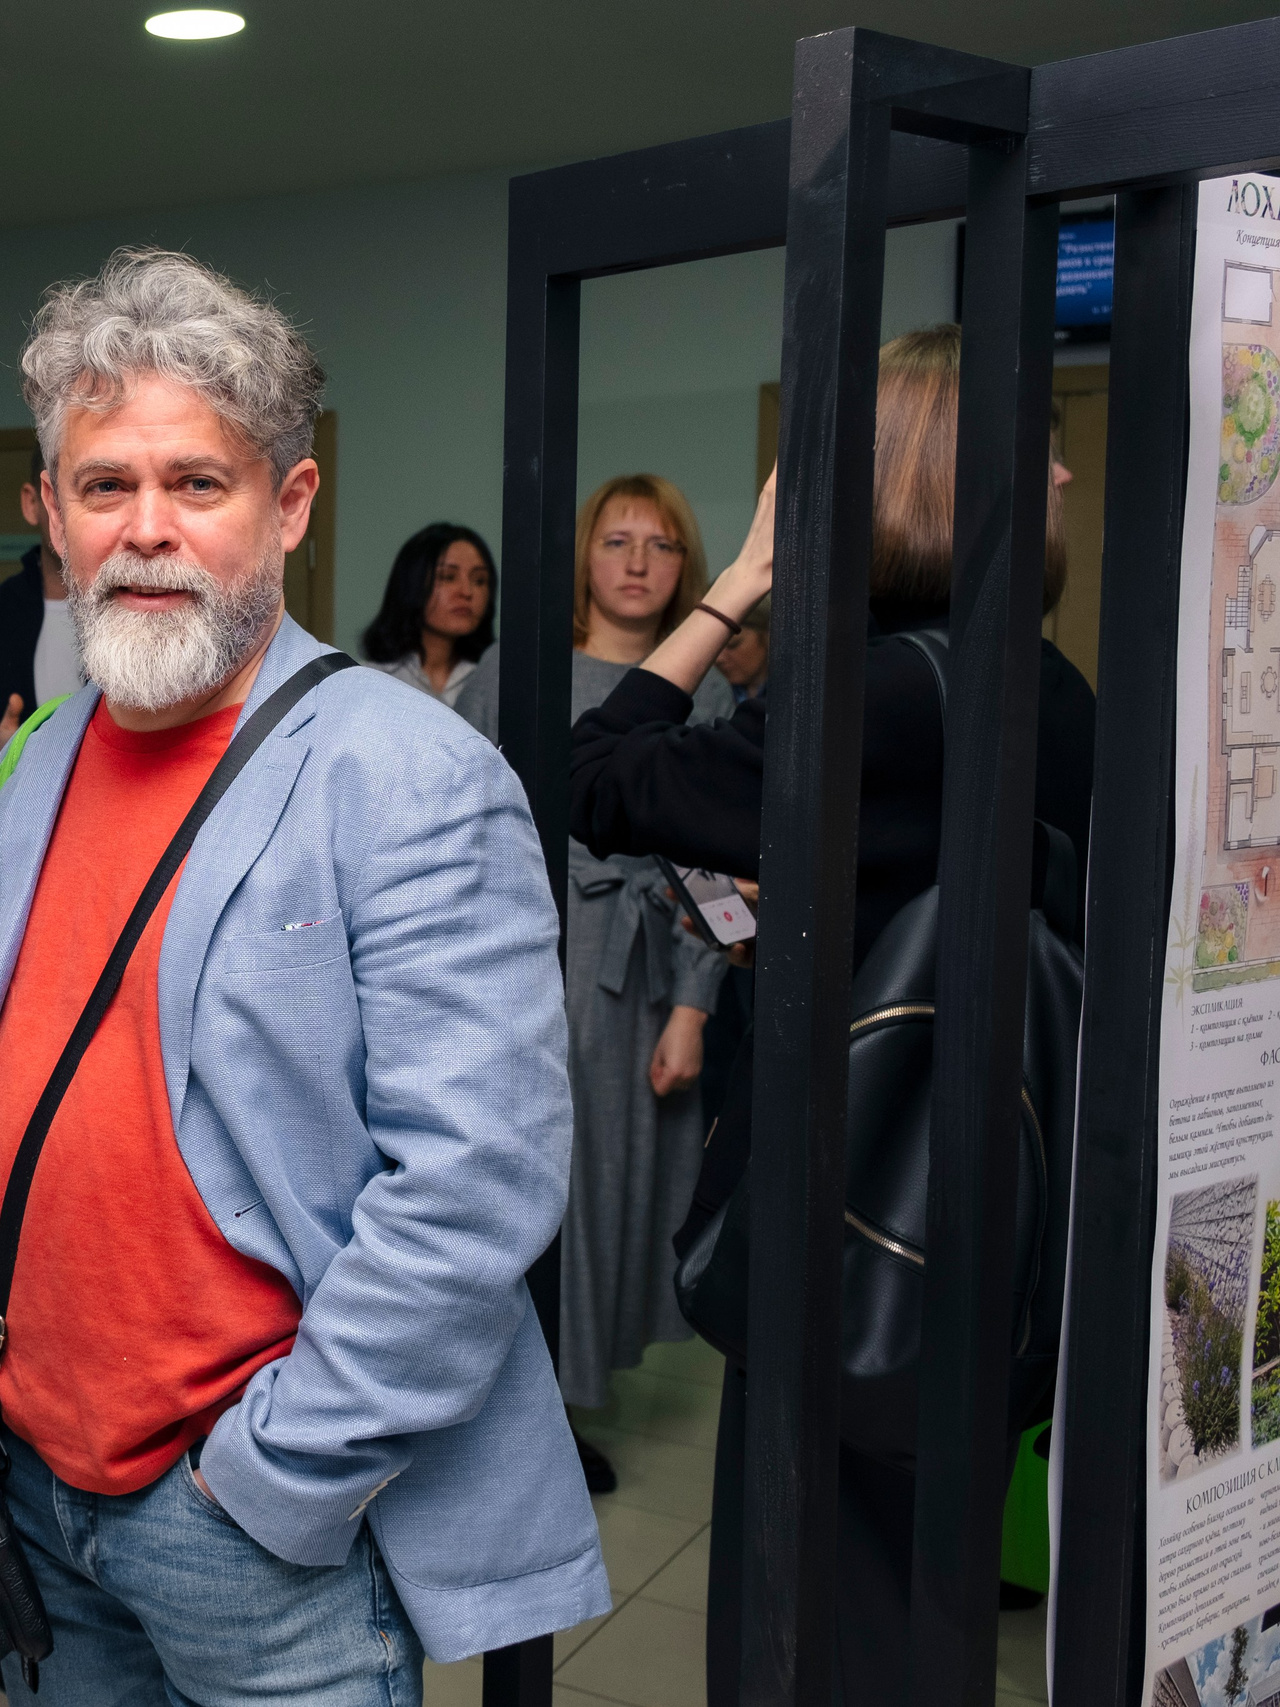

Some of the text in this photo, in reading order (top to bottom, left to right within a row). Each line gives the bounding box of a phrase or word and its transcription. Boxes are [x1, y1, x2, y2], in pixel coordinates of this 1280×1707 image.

[1227, 179, 1280, 221] ЛОХ
[1236, 229, 1280, 249] Концепция
[1190, 998, 1243, 1016] ЭКСПЛИКАЦИЯ
[1190, 1024, 1195, 1034] 1
[1200, 1018, 1237, 1034] композиция
[1190, 1041, 1194, 1052] 3
[1199, 1036, 1236, 1052] композиция
[1169, 1094, 1206, 1111] Ограждение
[1211, 1088, 1236, 1103] проекте
[1236, 1082, 1266, 1095] выполнено
[1169, 1115, 1191, 1127] бетона
[1226, 1099, 1263, 1114] заполненных
[1169, 1132, 1188, 1144] белым
[1215, 1118, 1237, 1133] Чтобы
[1238, 1115, 1264, 1128] добавить
[1168, 1170, 1179, 1180] мы
[1180, 1162, 1207, 1177] высадили
[1186, 1468, 1256, 1514] КОМПОЗИЦИЯ
[1258, 1464, 1265, 1480] С
[1158, 1609, 1193, 1633] Композицию
